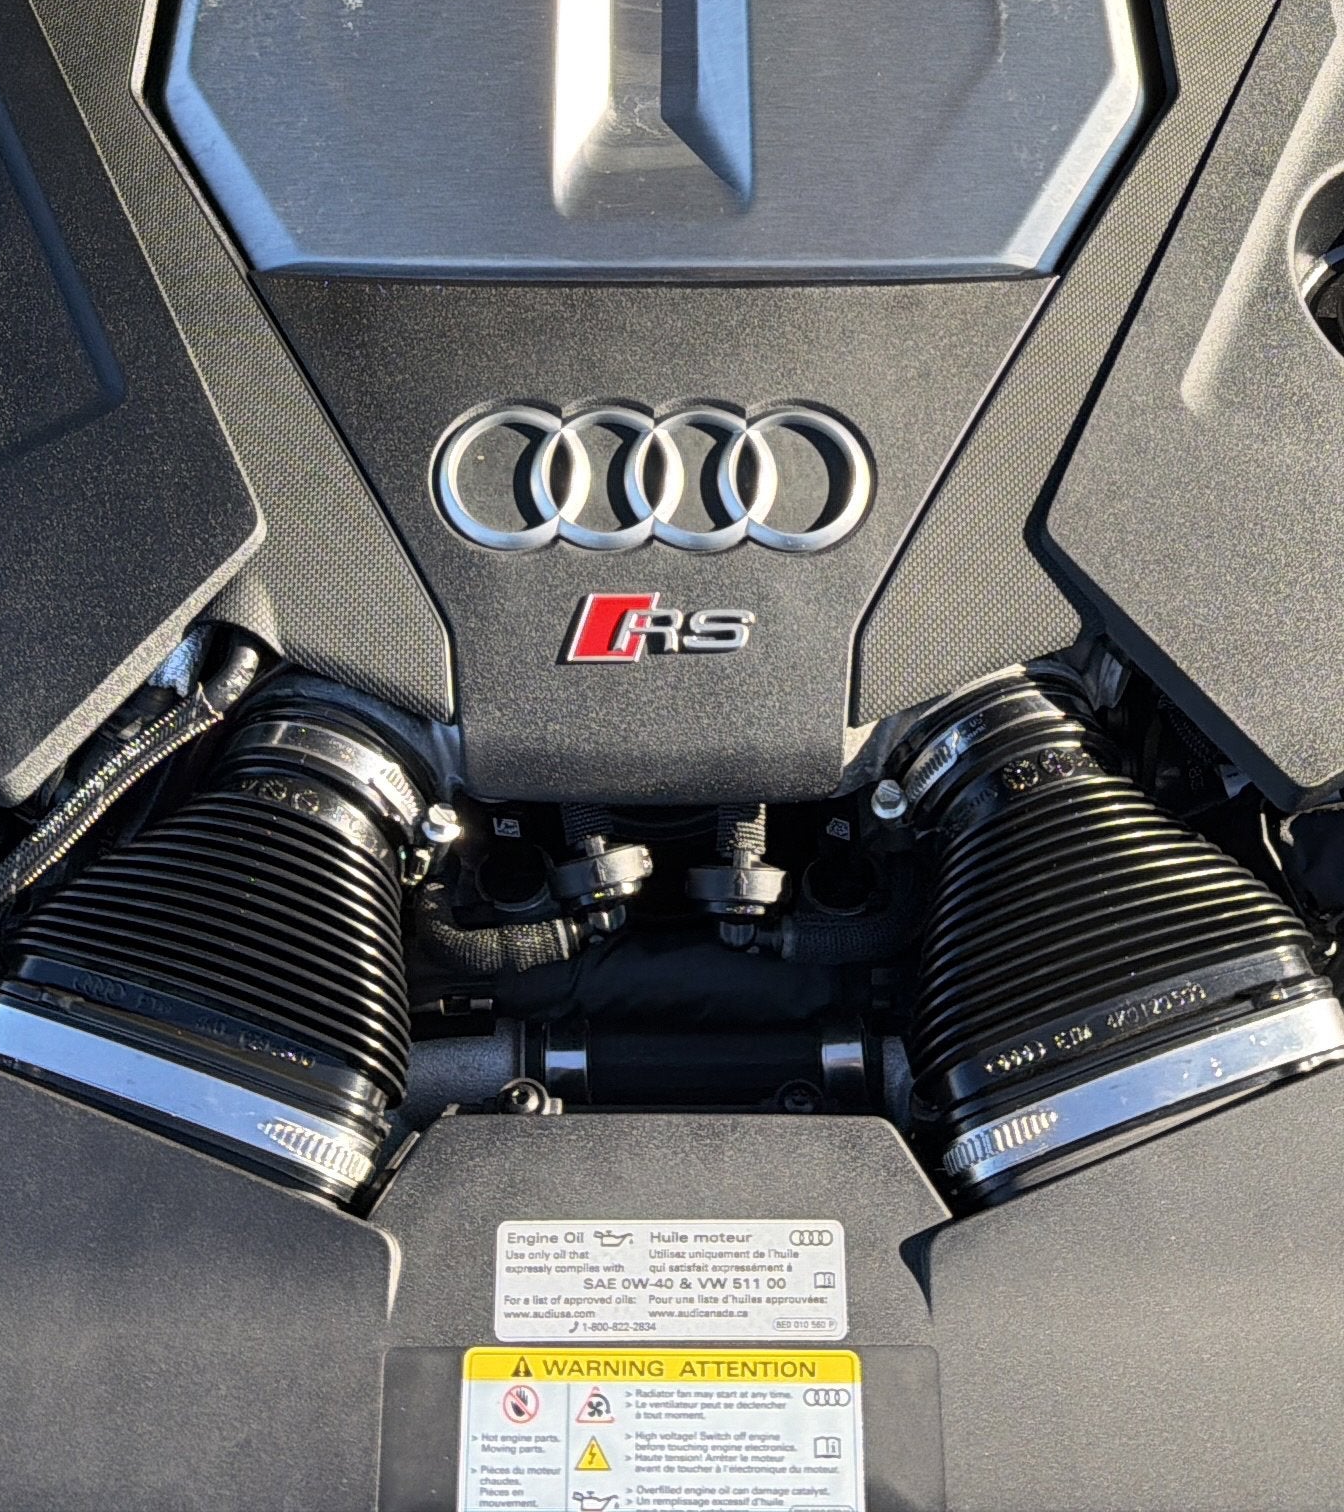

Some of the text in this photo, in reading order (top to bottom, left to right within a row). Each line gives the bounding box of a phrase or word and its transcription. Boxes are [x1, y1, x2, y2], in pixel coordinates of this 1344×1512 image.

[611, 608, 756, 655] RS
[507, 1231, 584, 1246] Engine Oil
[650, 1231, 753, 1243] Huile moteur
[505, 1249, 590, 1261] Use only oil that
[649, 1249, 800, 1260] Utilisez uniquement de l'huile
[505, 1263, 625, 1275] expressly complies with
[649, 1262, 793, 1274] qui satisfait expressément à
[583, 1277, 786, 1290] SAE 0W-40 & VW 511 00
[504, 1294, 637, 1306] For a list of approved oils:
[648, 1294, 674, 1304] Pour
[698, 1294, 719, 1304] liste
[722, 1294, 762, 1304] d'huiles
[765, 1295, 828, 1306] approuvées:
[503, 1309, 596, 1319] www.audiusa.com
[648, 1309, 748, 1318] www.audicanada.ca
[582, 1322, 657, 1332] 1-800-822-2834
[793, 1320, 809, 1329] 010
[542, 1360, 816, 1378] WARNING ATTENTION
[635, 1389, 793, 1400] Radiator fan may start at any time.
[635, 1401, 648, 1409] Le
[649, 1401, 699, 1409] ventilateur
[700, 1402, 722, 1410] peut
[635, 1411, 642, 1420] à
[664, 1412, 706, 1420] moment.
[481, 1433, 561, 1444] Hot engine parts.
[635, 1432, 781, 1443] High voltage! Switch off engine
[481, 1444, 546, 1455] Moving parts.
[635, 1442, 797, 1453] before touching engine electronics.
[634, 1453, 663, 1462] Haute
[664, 1454, 703, 1462] tension!
[739, 1454, 749, 1462] le
[751, 1455, 785, 1463] moteur
[512, 1466, 525, 1475] du
[527, 1467, 562, 1475] moteur
[634, 1465, 661, 1473] avant
[663, 1465, 676, 1473] de
[677, 1465, 713, 1473] toucher
[715, 1465, 722, 1474] à
[788, 1465, 802, 1474] du
[803, 1466, 840, 1474] moteur.
[479, 1477, 522, 1486] chaudes.
[511, 1489, 524, 1497] en
[636, 1486, 682, 1496] Overfilled
[684, 1486, 717, 1496] engine
[718, 1486, 731, 1495] oil
[732, 1488, 749, 1496] can
[751, 1486, 790, 1497] damage
[479, 1500, 540, 1508] mouvement.
[636, 1497, 785, 1508] Un remplissage excessif d'huile
